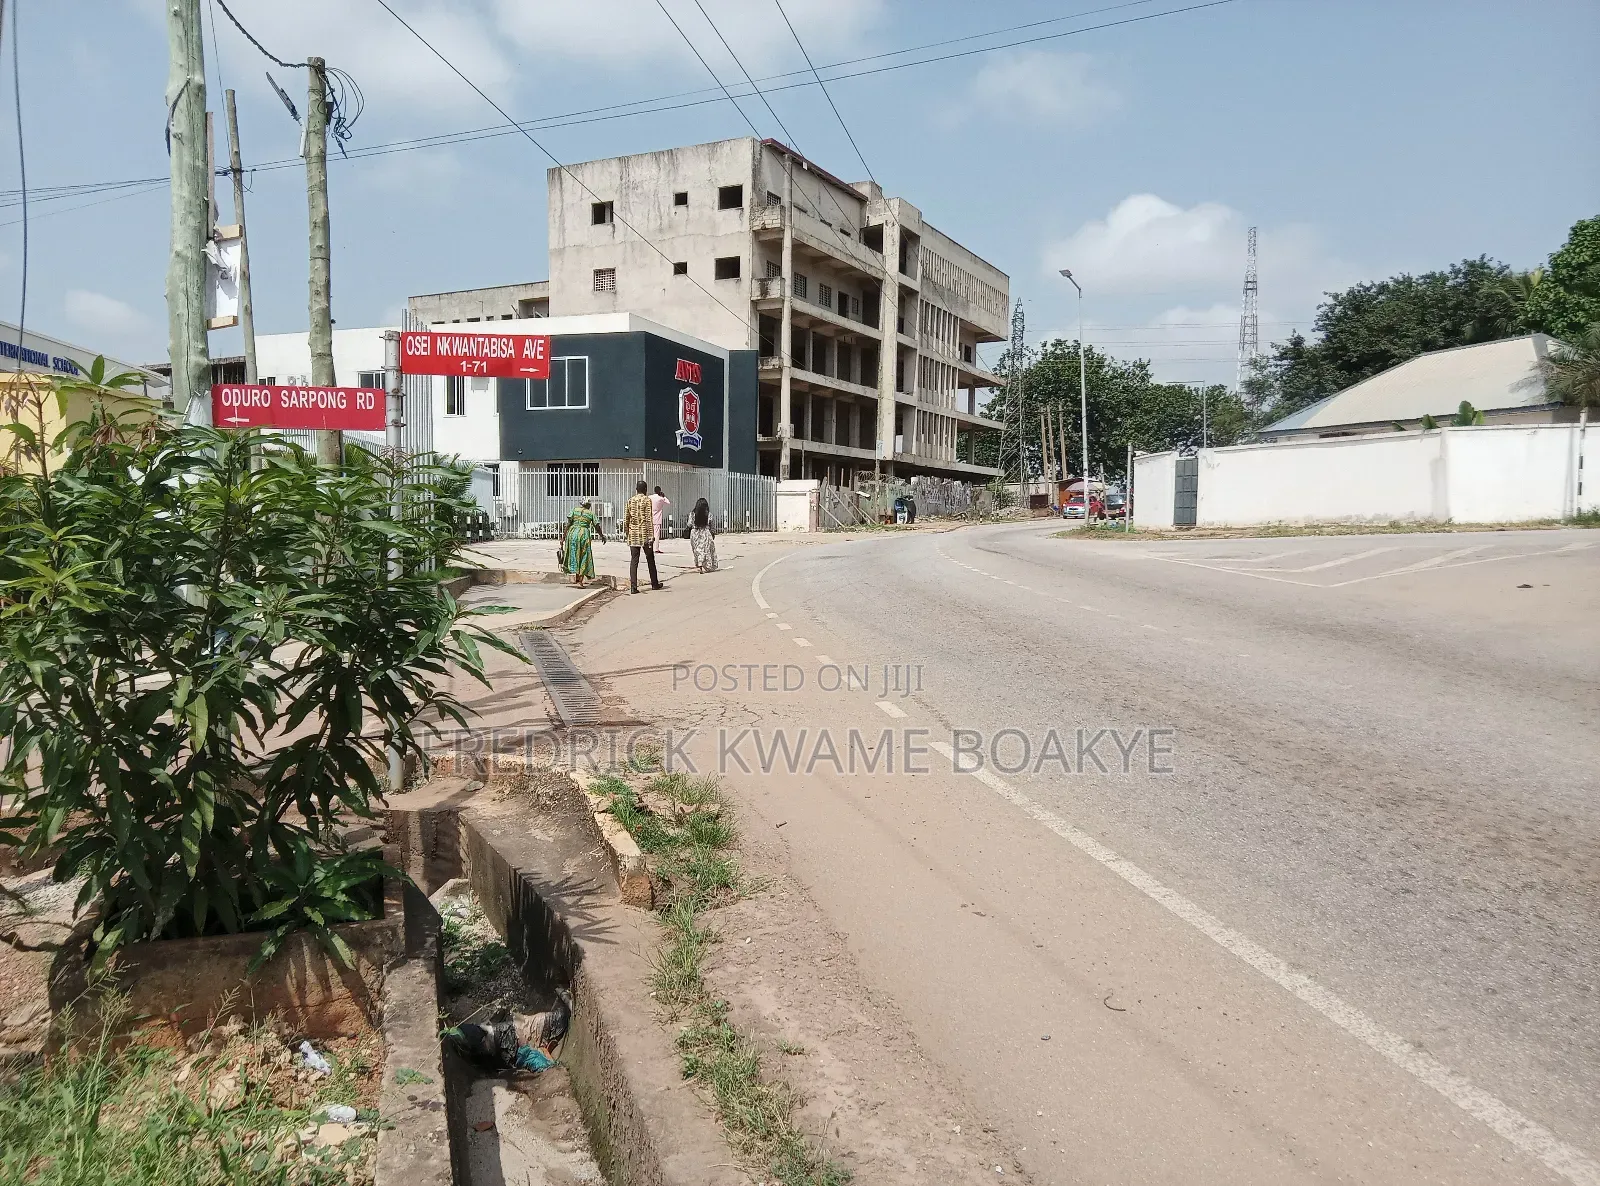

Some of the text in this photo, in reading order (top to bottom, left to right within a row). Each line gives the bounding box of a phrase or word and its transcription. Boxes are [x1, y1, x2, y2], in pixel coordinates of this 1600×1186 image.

[406, 335, 545, 360] OSEI NKWANTABISA AVE
[460, 360, 488, 373] 1-71
[221, 388, 375, 410] ODURO SARPONG RD
